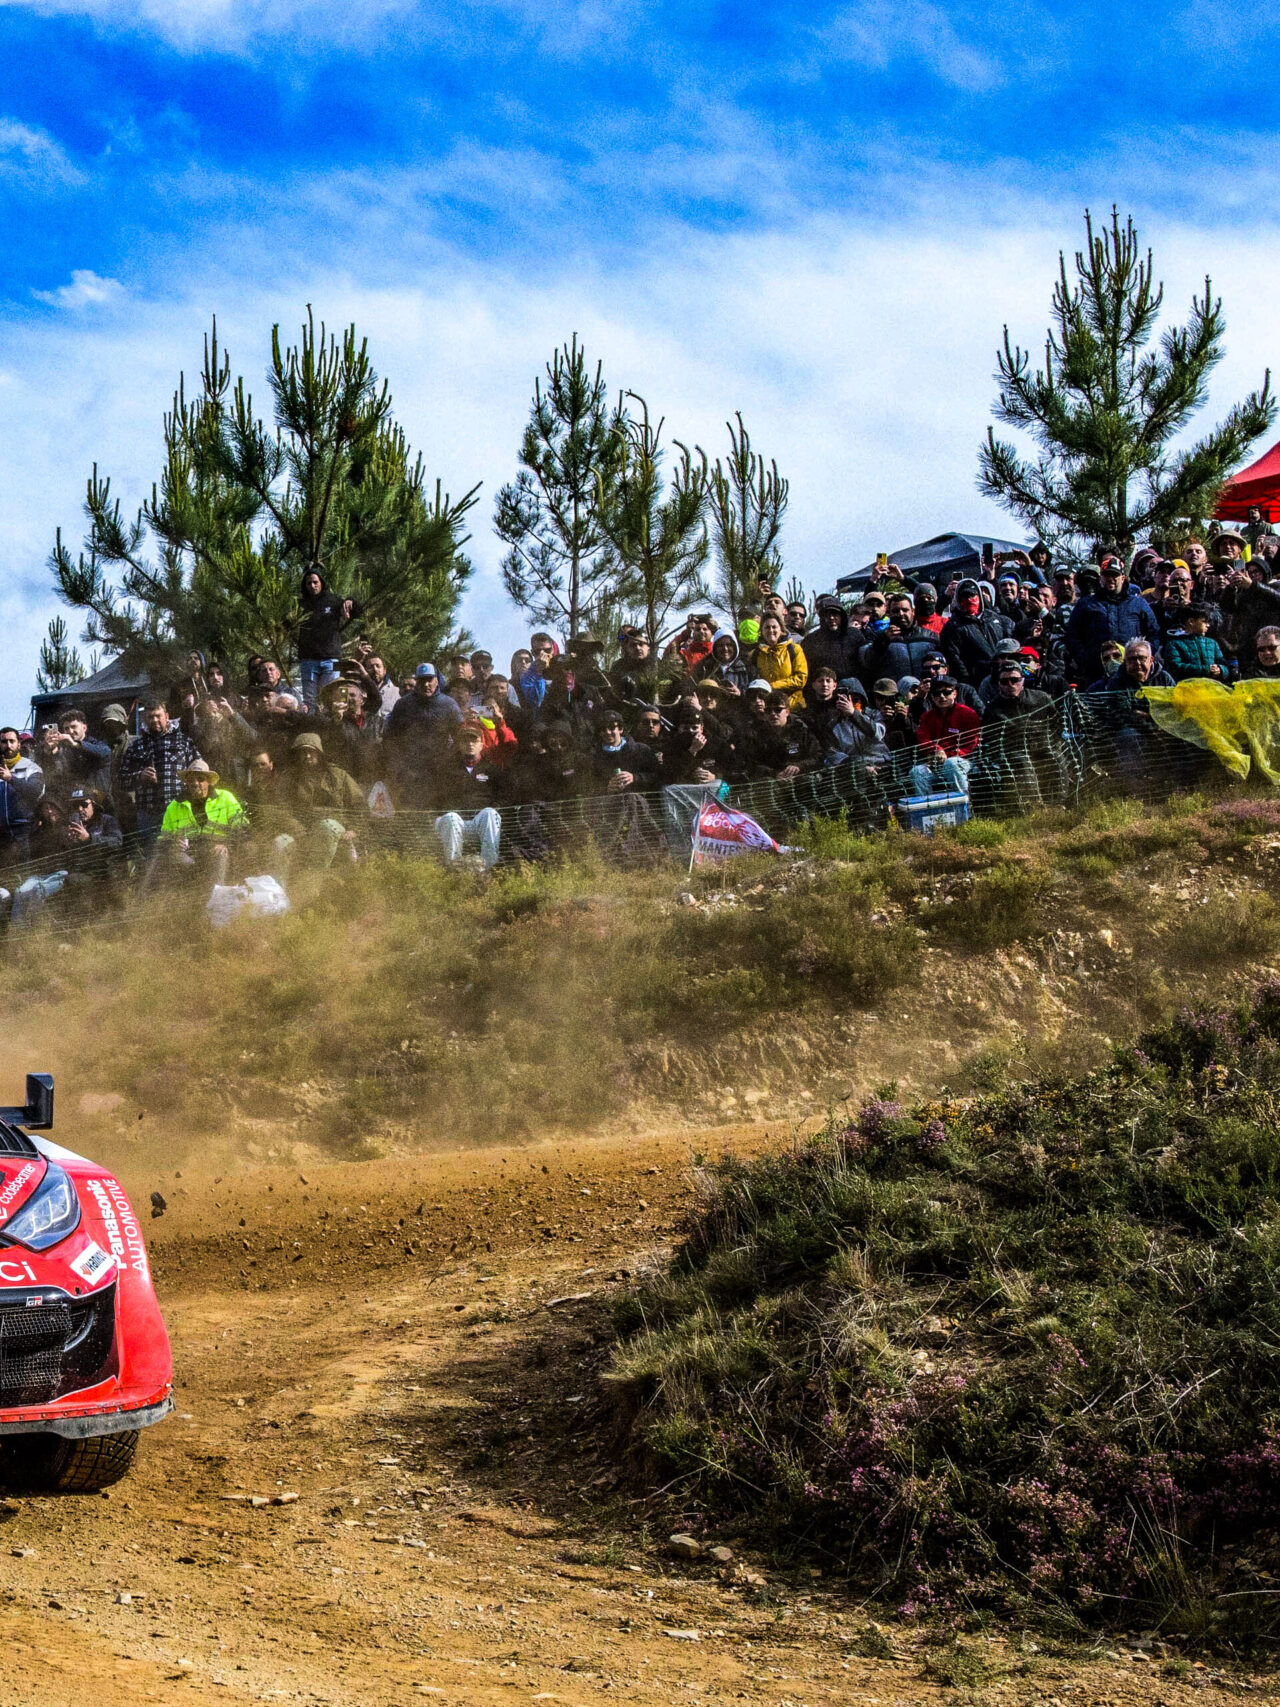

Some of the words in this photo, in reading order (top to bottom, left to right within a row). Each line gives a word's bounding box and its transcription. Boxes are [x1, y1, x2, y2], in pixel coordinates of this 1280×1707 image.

[0, 1162, 37, 1205] codebeamer
[86, 1179, 128, 1270] Panasonic
[102, 1178, 146, 1272] AUTOMOTIVE
